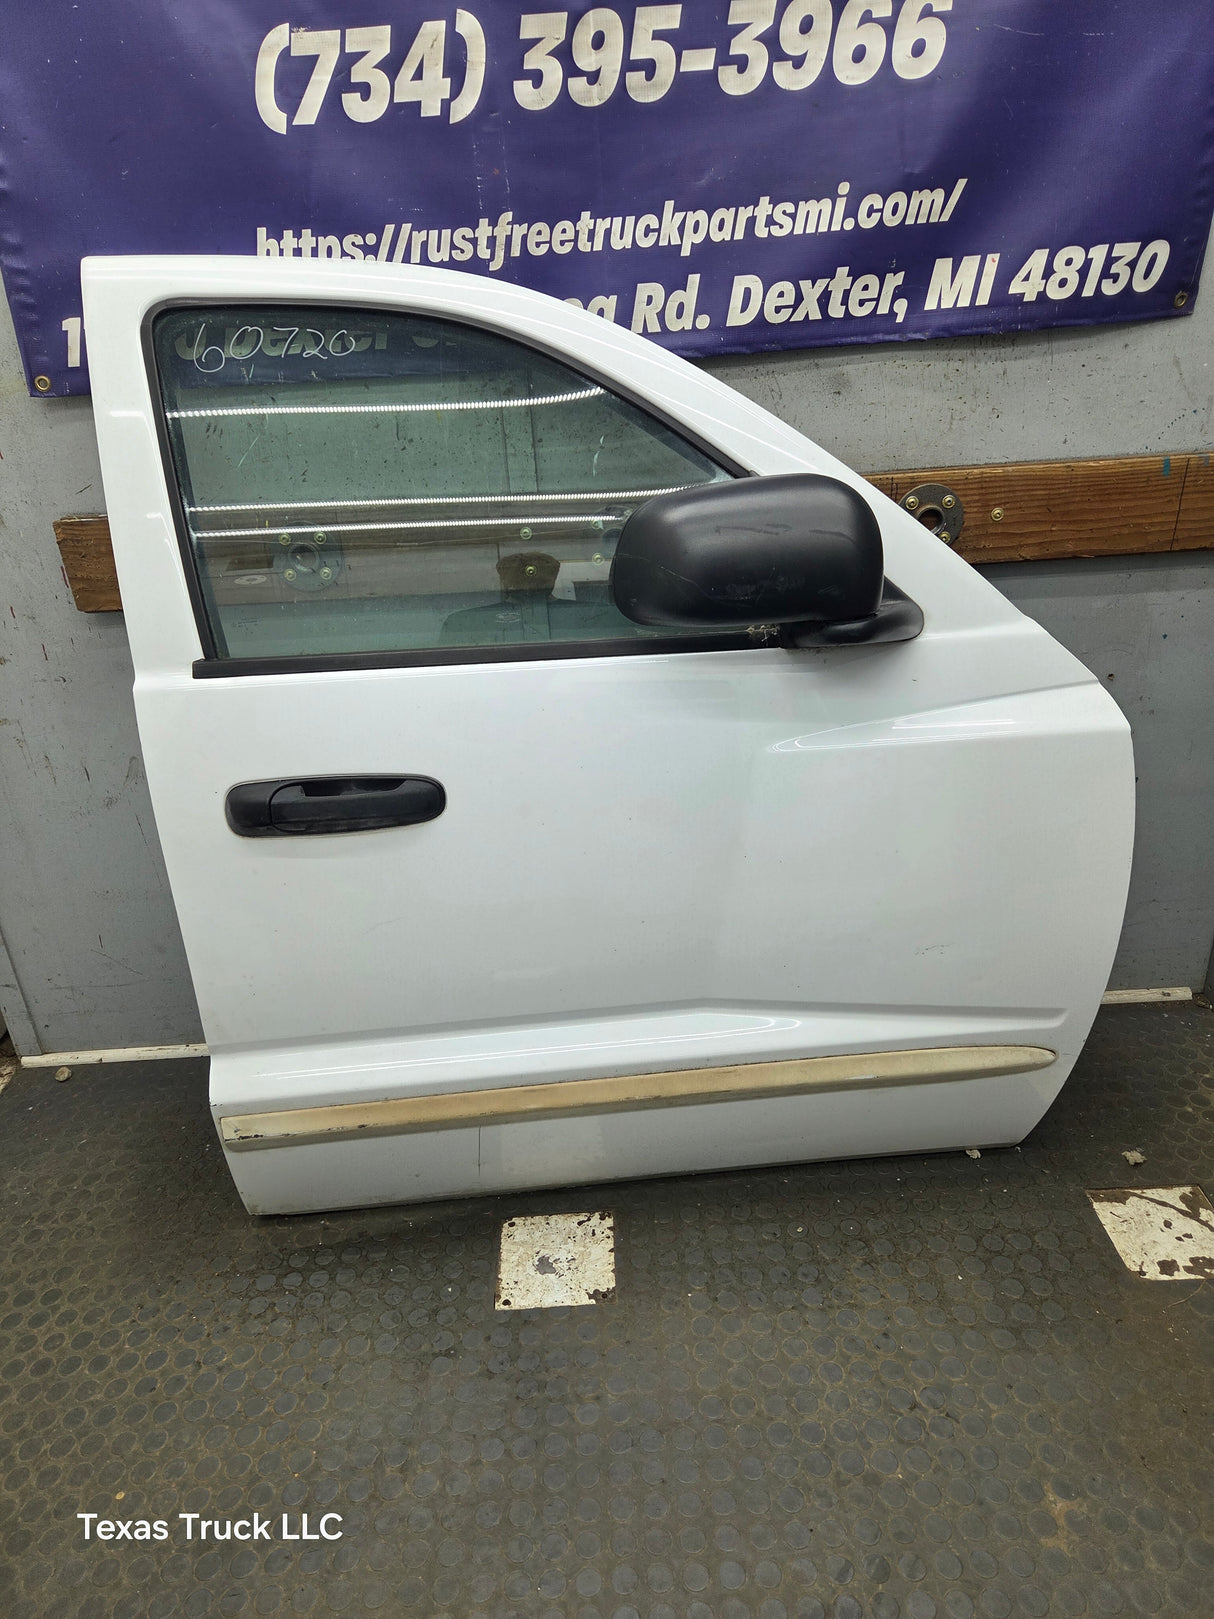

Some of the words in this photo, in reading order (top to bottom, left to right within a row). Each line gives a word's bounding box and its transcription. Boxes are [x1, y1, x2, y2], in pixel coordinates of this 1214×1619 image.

[255, 8, 487, 135] (734)
[513, 0, 953, 111] 395-3966
[630, 273, 711, 334] Rd.
[725, 266, 907, 324] Dexter,
[923, 253, 1000, 311] MI
[1008, 239, 1171, 302] 48130
[193, 322, 356, 374] 60720
